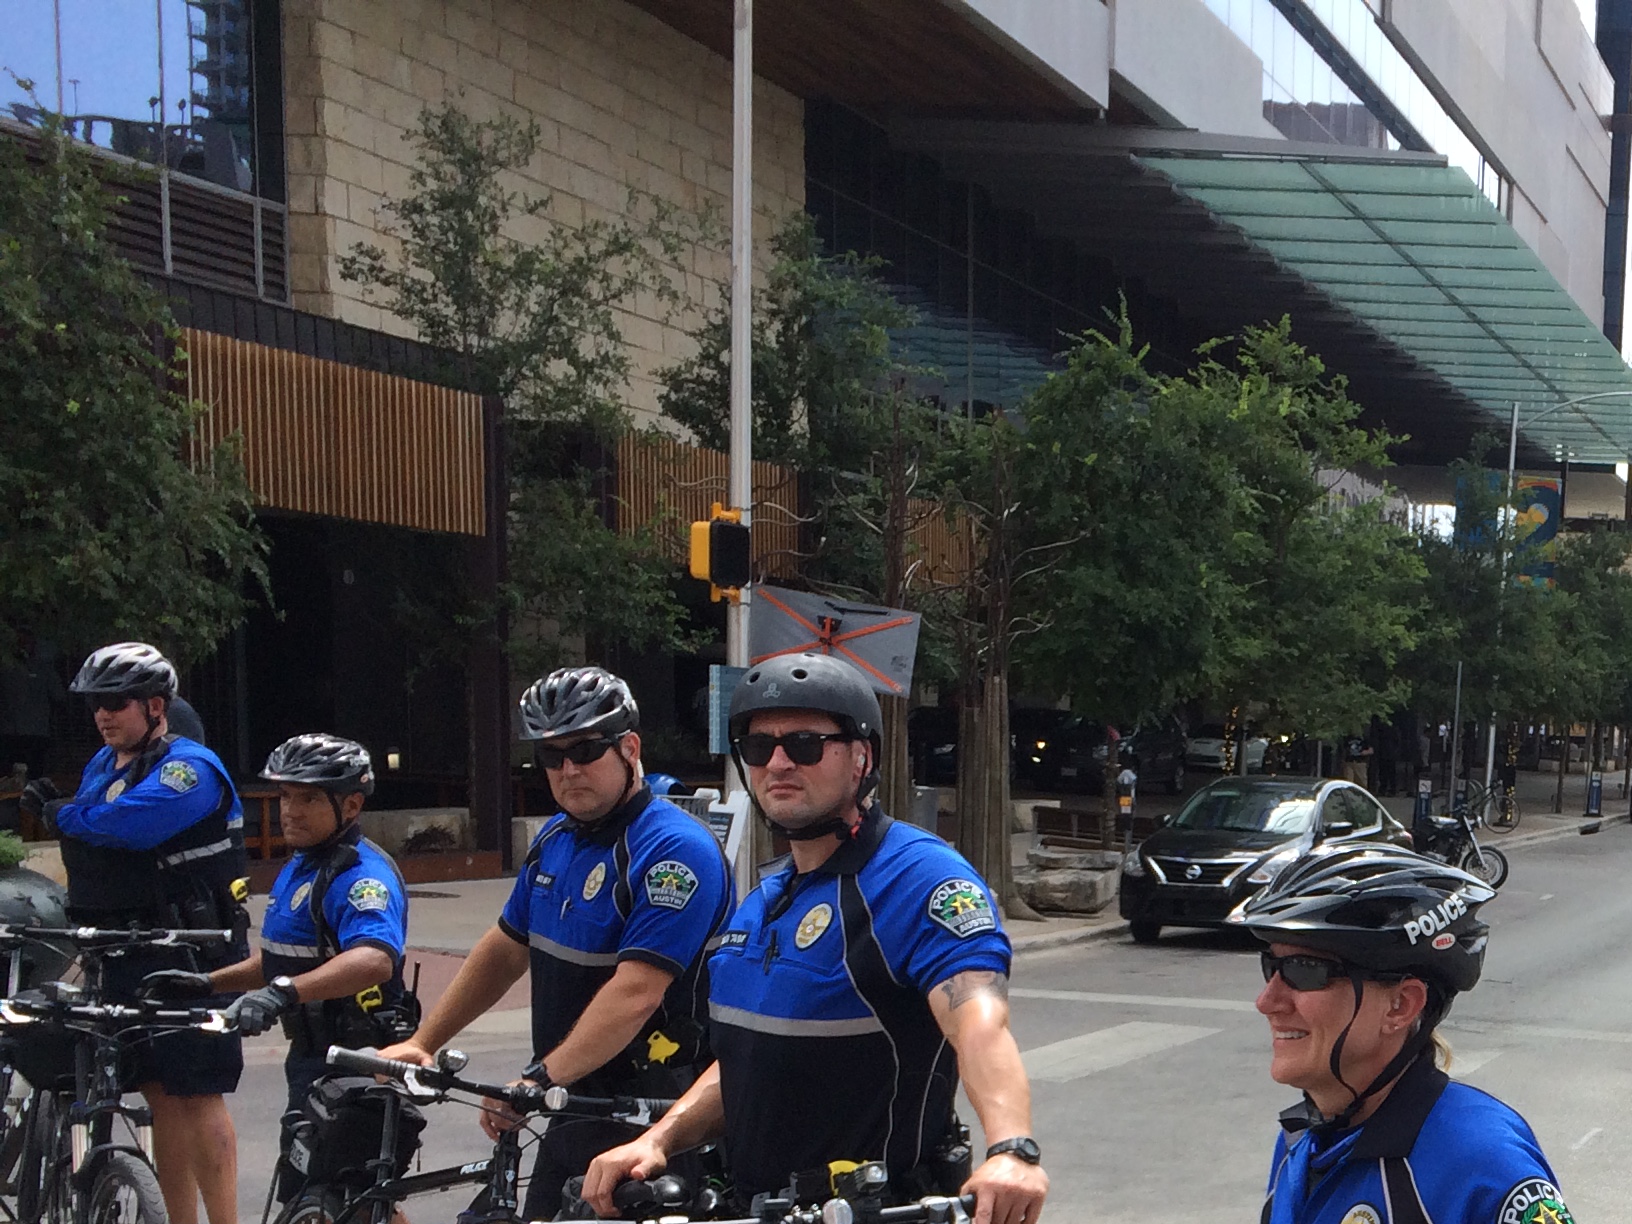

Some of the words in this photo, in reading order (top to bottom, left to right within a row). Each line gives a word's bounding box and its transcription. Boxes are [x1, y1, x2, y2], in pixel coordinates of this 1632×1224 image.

[650, 864, 695, 884] POLICE
[931, 882, 985, 911] POLICE
[1403, 893, 1467, 945] POLICE
[1435, 937, 1453, 947] BELL
